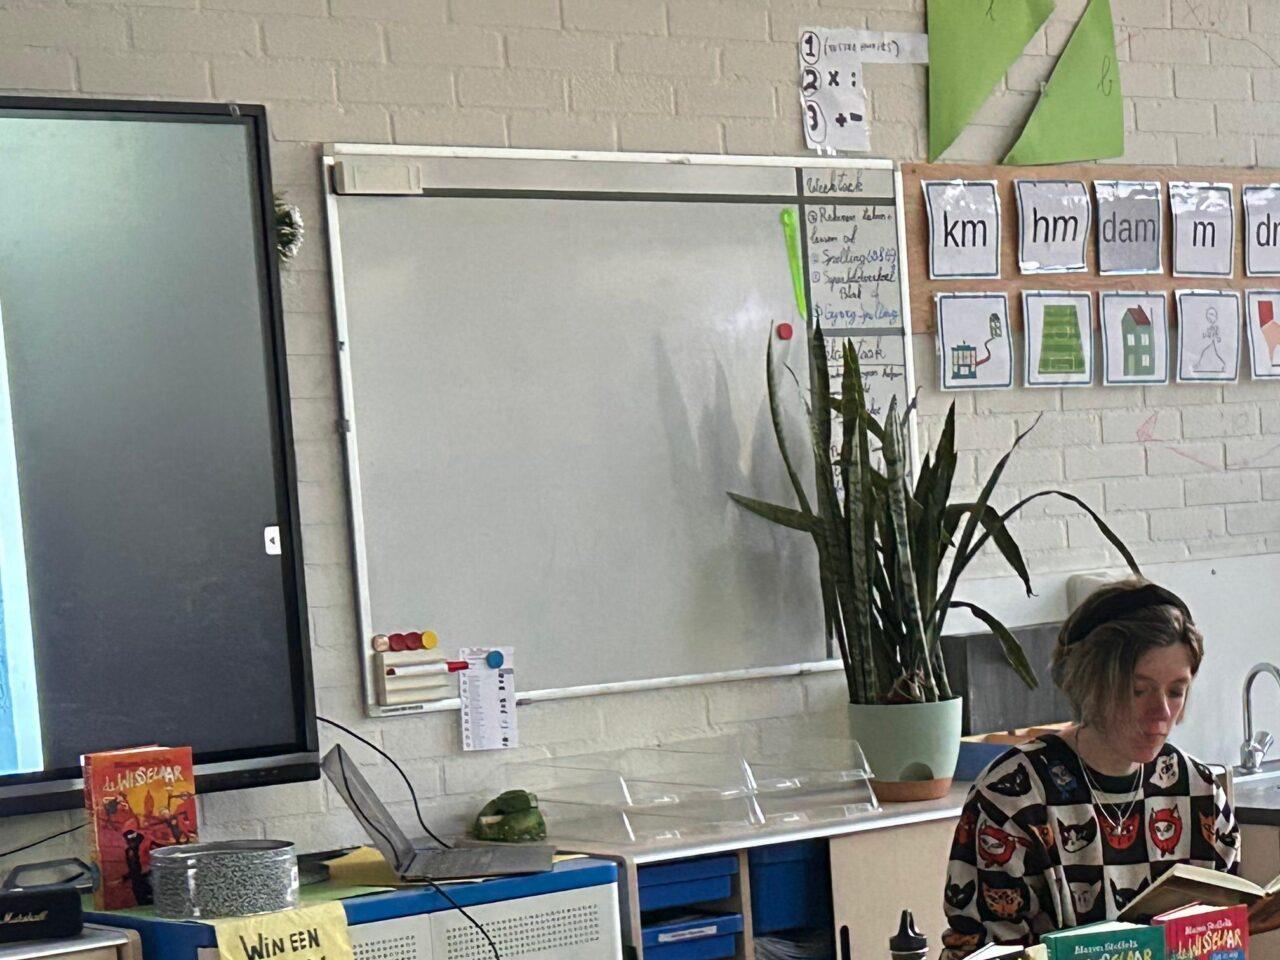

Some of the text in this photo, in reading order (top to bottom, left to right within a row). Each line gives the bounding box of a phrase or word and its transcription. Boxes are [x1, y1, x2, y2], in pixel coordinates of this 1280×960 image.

[803, 67, 820, 94] 2
[943, 210, 988, 247] km
[1032, 207, 1078, 243] hm
[1102, 211, 1156, 243] dam
[1193, 220, 1215, 247] m
[290, 928, 320, 952] EEN
